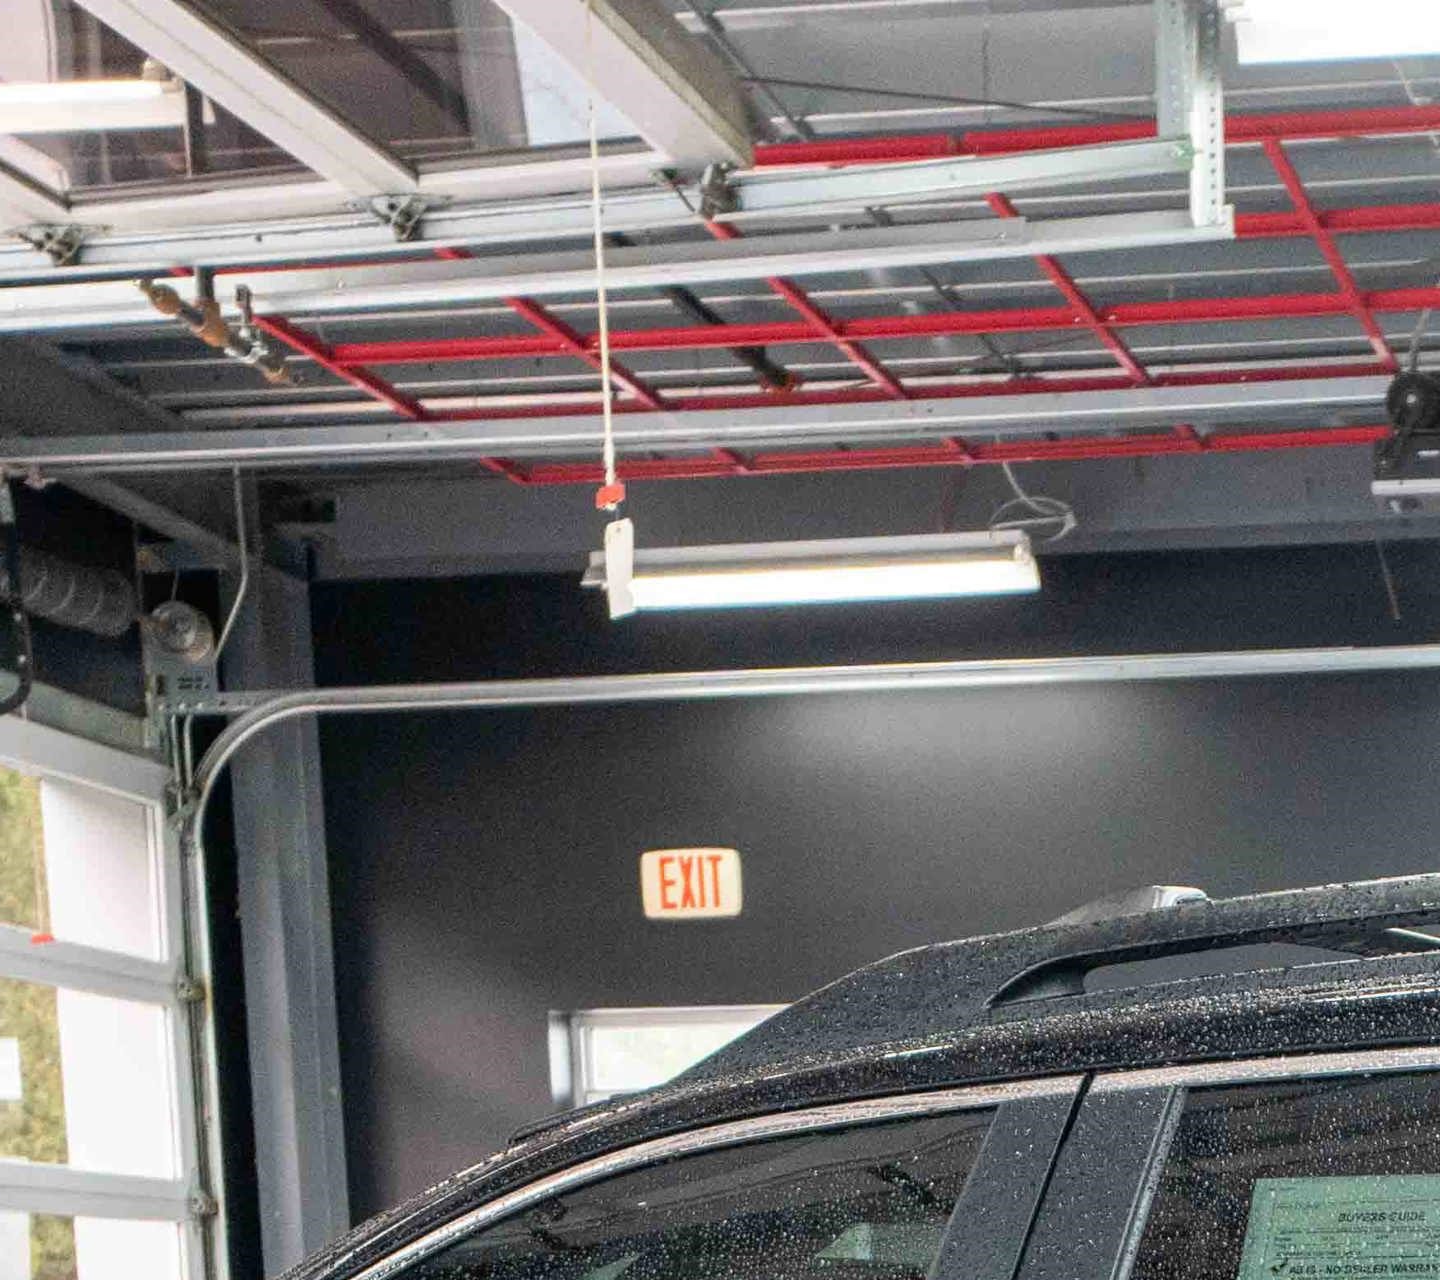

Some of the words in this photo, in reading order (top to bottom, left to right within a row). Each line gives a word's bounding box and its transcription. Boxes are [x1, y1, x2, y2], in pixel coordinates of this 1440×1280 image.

[659, 855, 721, 909] EXIT
[1339, 1211, 1386, 1222] BUYERS
[1389, 1211, 1426, 1222] GUIDE
[1326, 1264, 1342, 1274] NO
[1344, 1264, 1388, 1274] DEALER
